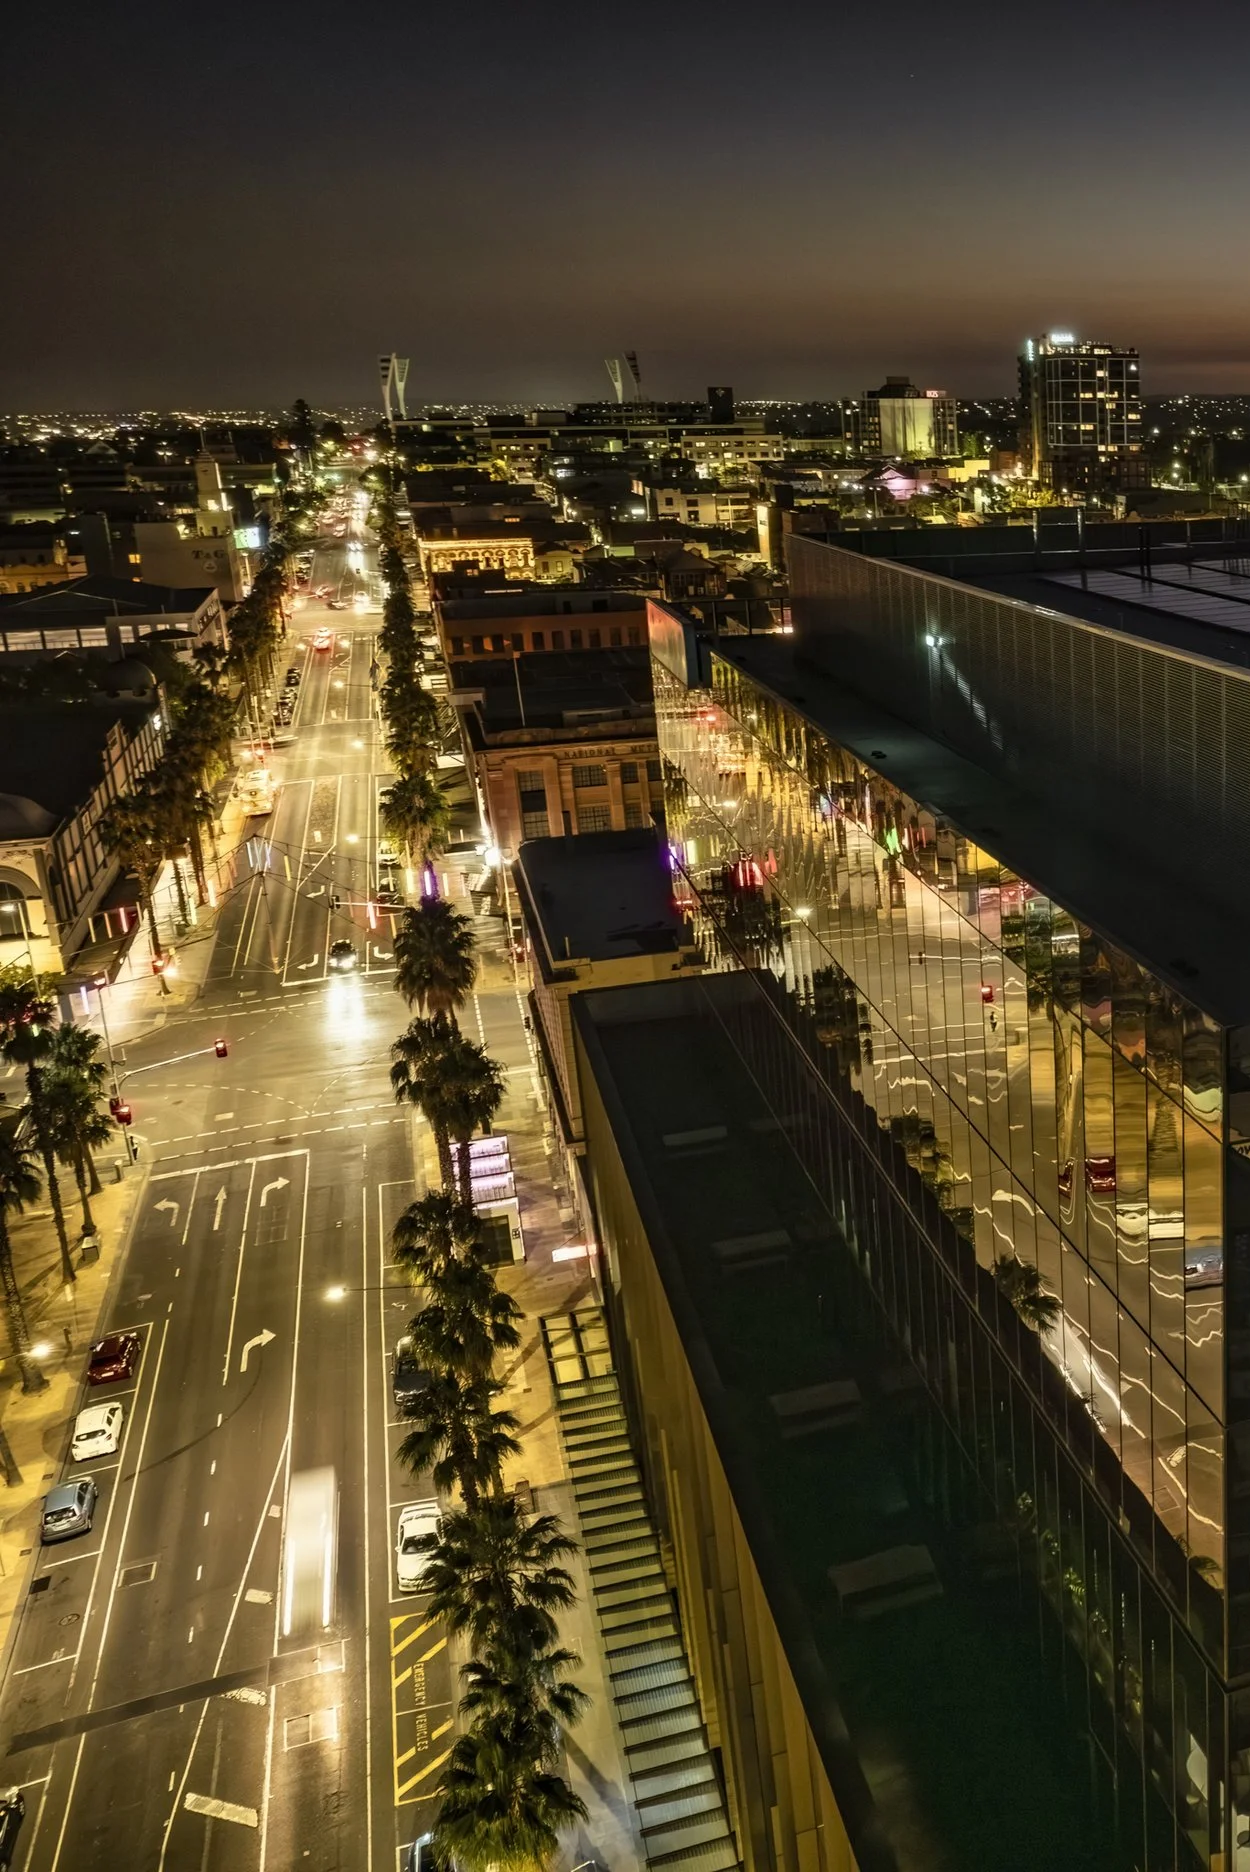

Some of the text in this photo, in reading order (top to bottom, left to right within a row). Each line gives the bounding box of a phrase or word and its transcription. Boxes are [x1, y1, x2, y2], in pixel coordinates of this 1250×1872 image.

[564, 746, 616, 759] NATIONAL
[413, 1662, 429, 1752] EMERGENCY VEHICLES
